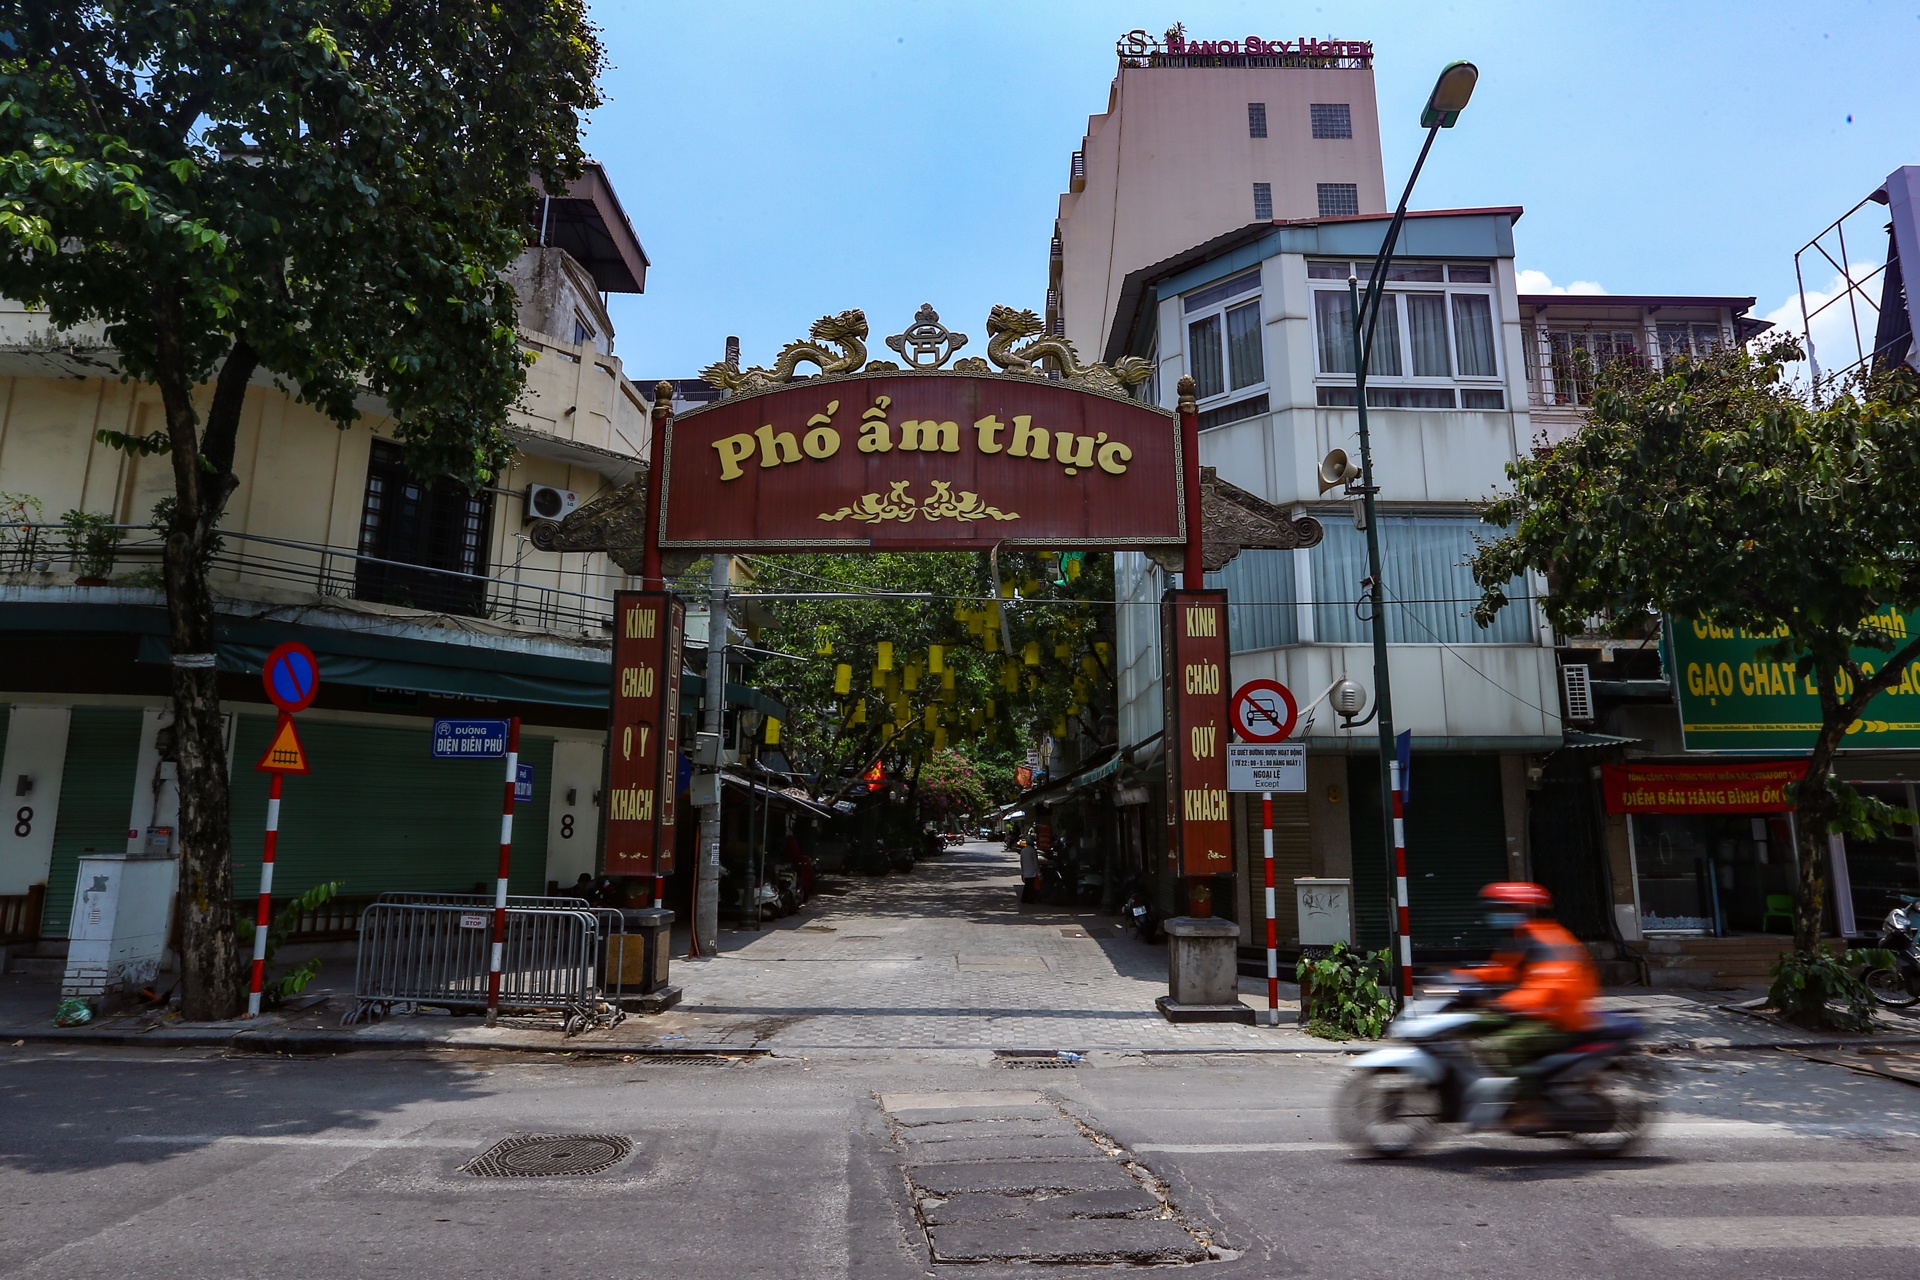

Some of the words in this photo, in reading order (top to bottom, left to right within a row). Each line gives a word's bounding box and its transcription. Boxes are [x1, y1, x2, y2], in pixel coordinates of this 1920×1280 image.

[1167, 37, 1241, 56] HANOI
[1299, 37, 1373, 57] HOTEL
[712, 400, 840, 481] Phố
[857, 395, 960, 453] ẩm
[973, 414, 1133, 475] thực
[625, 603, 656, 638] KÍNH
[1186, 601, 1217, 637] KÍNH
[621, 662, 654, 697] CHÀO
[1185, 658, 1220, 695] CHÀO
[1687, 661, 1734, 706] GẠO
[437, 736, 459, 754] ĐIỆN
[461, 736, 482, 752] BIÊN
[484, 734, 502, 752] PHỦ
[1191, 720, 1216, 761] QUÝ
[1253, 770, 1272, 779] NGOẠI
[1273, 769, 1281, 780] LỆ
[1255, 780, 1279, 788] Except
[610, 782, 653, 820] KHÁCH
[1184, 783, 1228, 821] KHÁCH
[1658, 788, 1686, 805] BÁN
[1688, 788, 1725, 804] HÀNG
[1727, 787, 1760, 804] BÌNH
[15, 806, 34, 837] 8
[560, 814, 575, 839] 8
